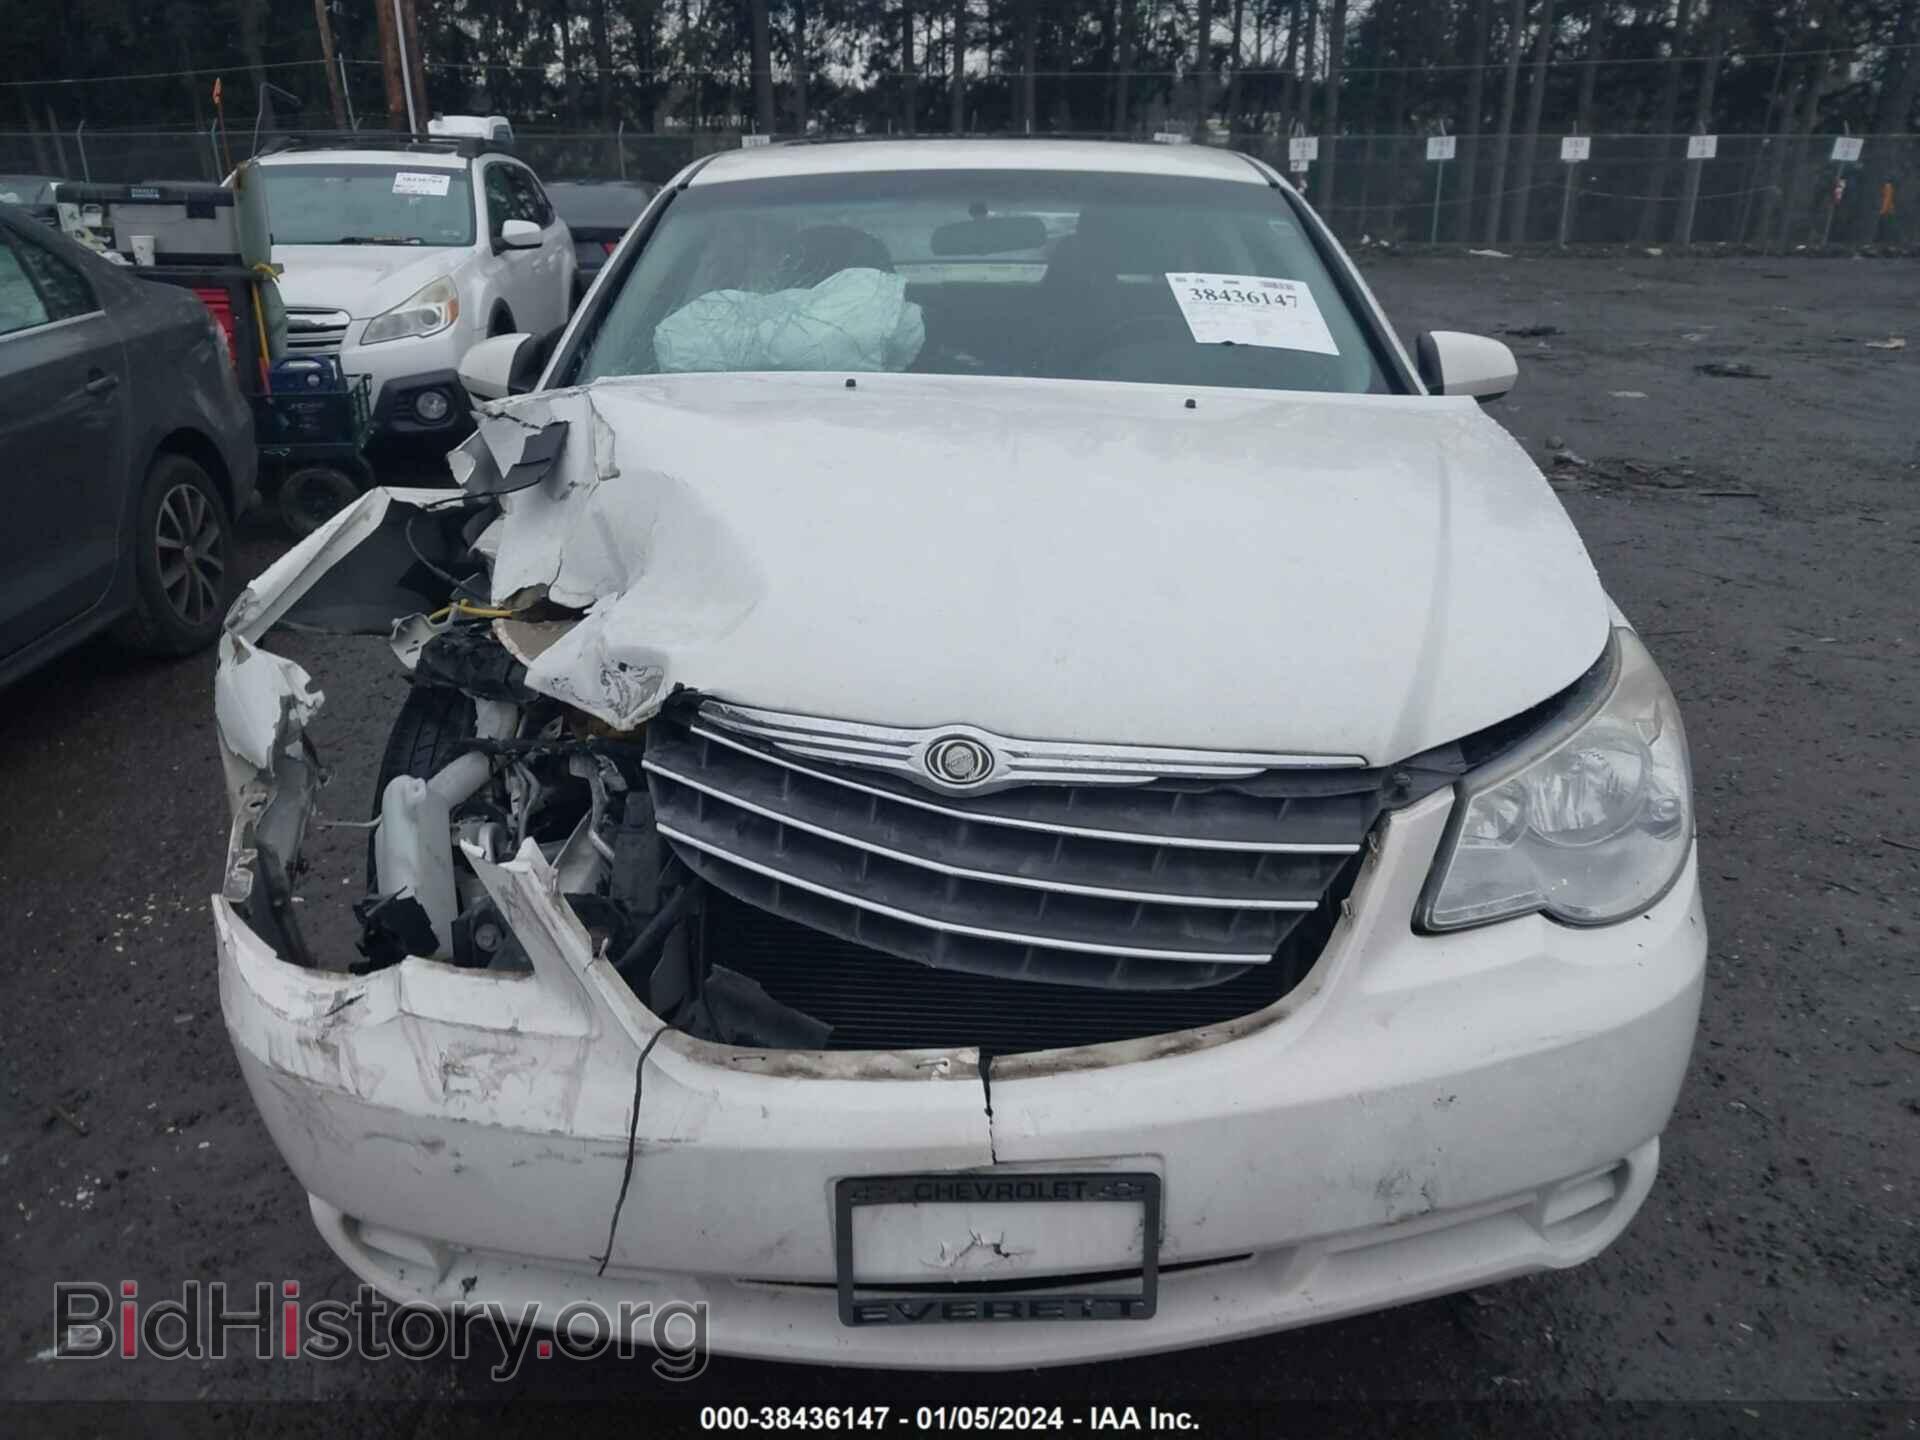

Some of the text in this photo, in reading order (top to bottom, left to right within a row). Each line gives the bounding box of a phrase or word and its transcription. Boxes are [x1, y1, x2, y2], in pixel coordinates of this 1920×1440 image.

[1189, 288, 1298, 308] 38436147
[913, 1181, 1088, 1201] CHEVROLET
[852, 1299, 1146, 1324] EVERETT
